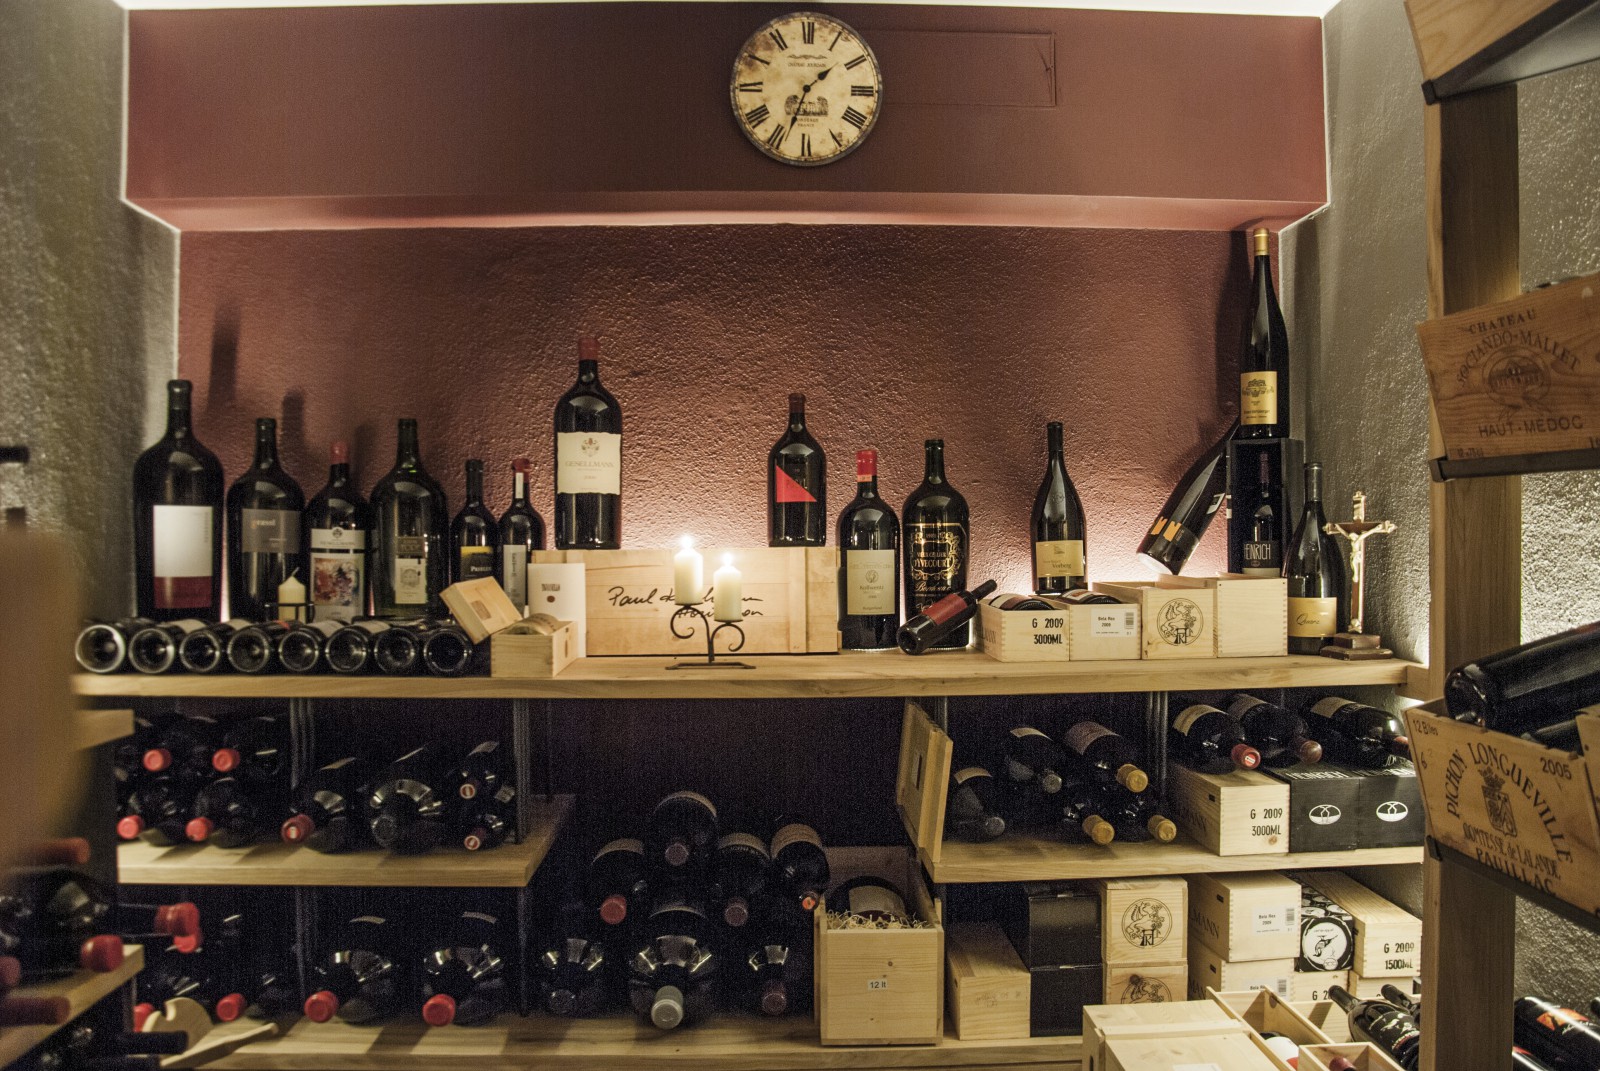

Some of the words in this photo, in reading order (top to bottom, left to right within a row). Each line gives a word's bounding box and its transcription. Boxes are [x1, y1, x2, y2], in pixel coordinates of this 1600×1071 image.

[1468, 308, 1536, 335] CHATEAU
[1244, 543, 1271, 560] HEINRICH
[608, 586, 658, 607] Paul
[1031, 618, 1038, 629] G
[1044, 617, 1064, 629] 2009
[1033, 633, 1063, 645] 3000ML
[1413, 719, 1421, 731] 12
[1540, 756, 1572, 781] 2005
[1444, 748, 1468, 819] PICHON
[1467, 742, 1574, 864] LONGUEVILLE
[1250, 808, 1257, 819] G
[1263, 807, 1283, 819] 2009
[1251, 825, 1282, 836] 3000ML
[1384, 943, 1390, 954] G
[1395, 942, 1415, 953] 2009
[870, 981, 880, 989] 12
[1312, 990, 1318, 1001] G
